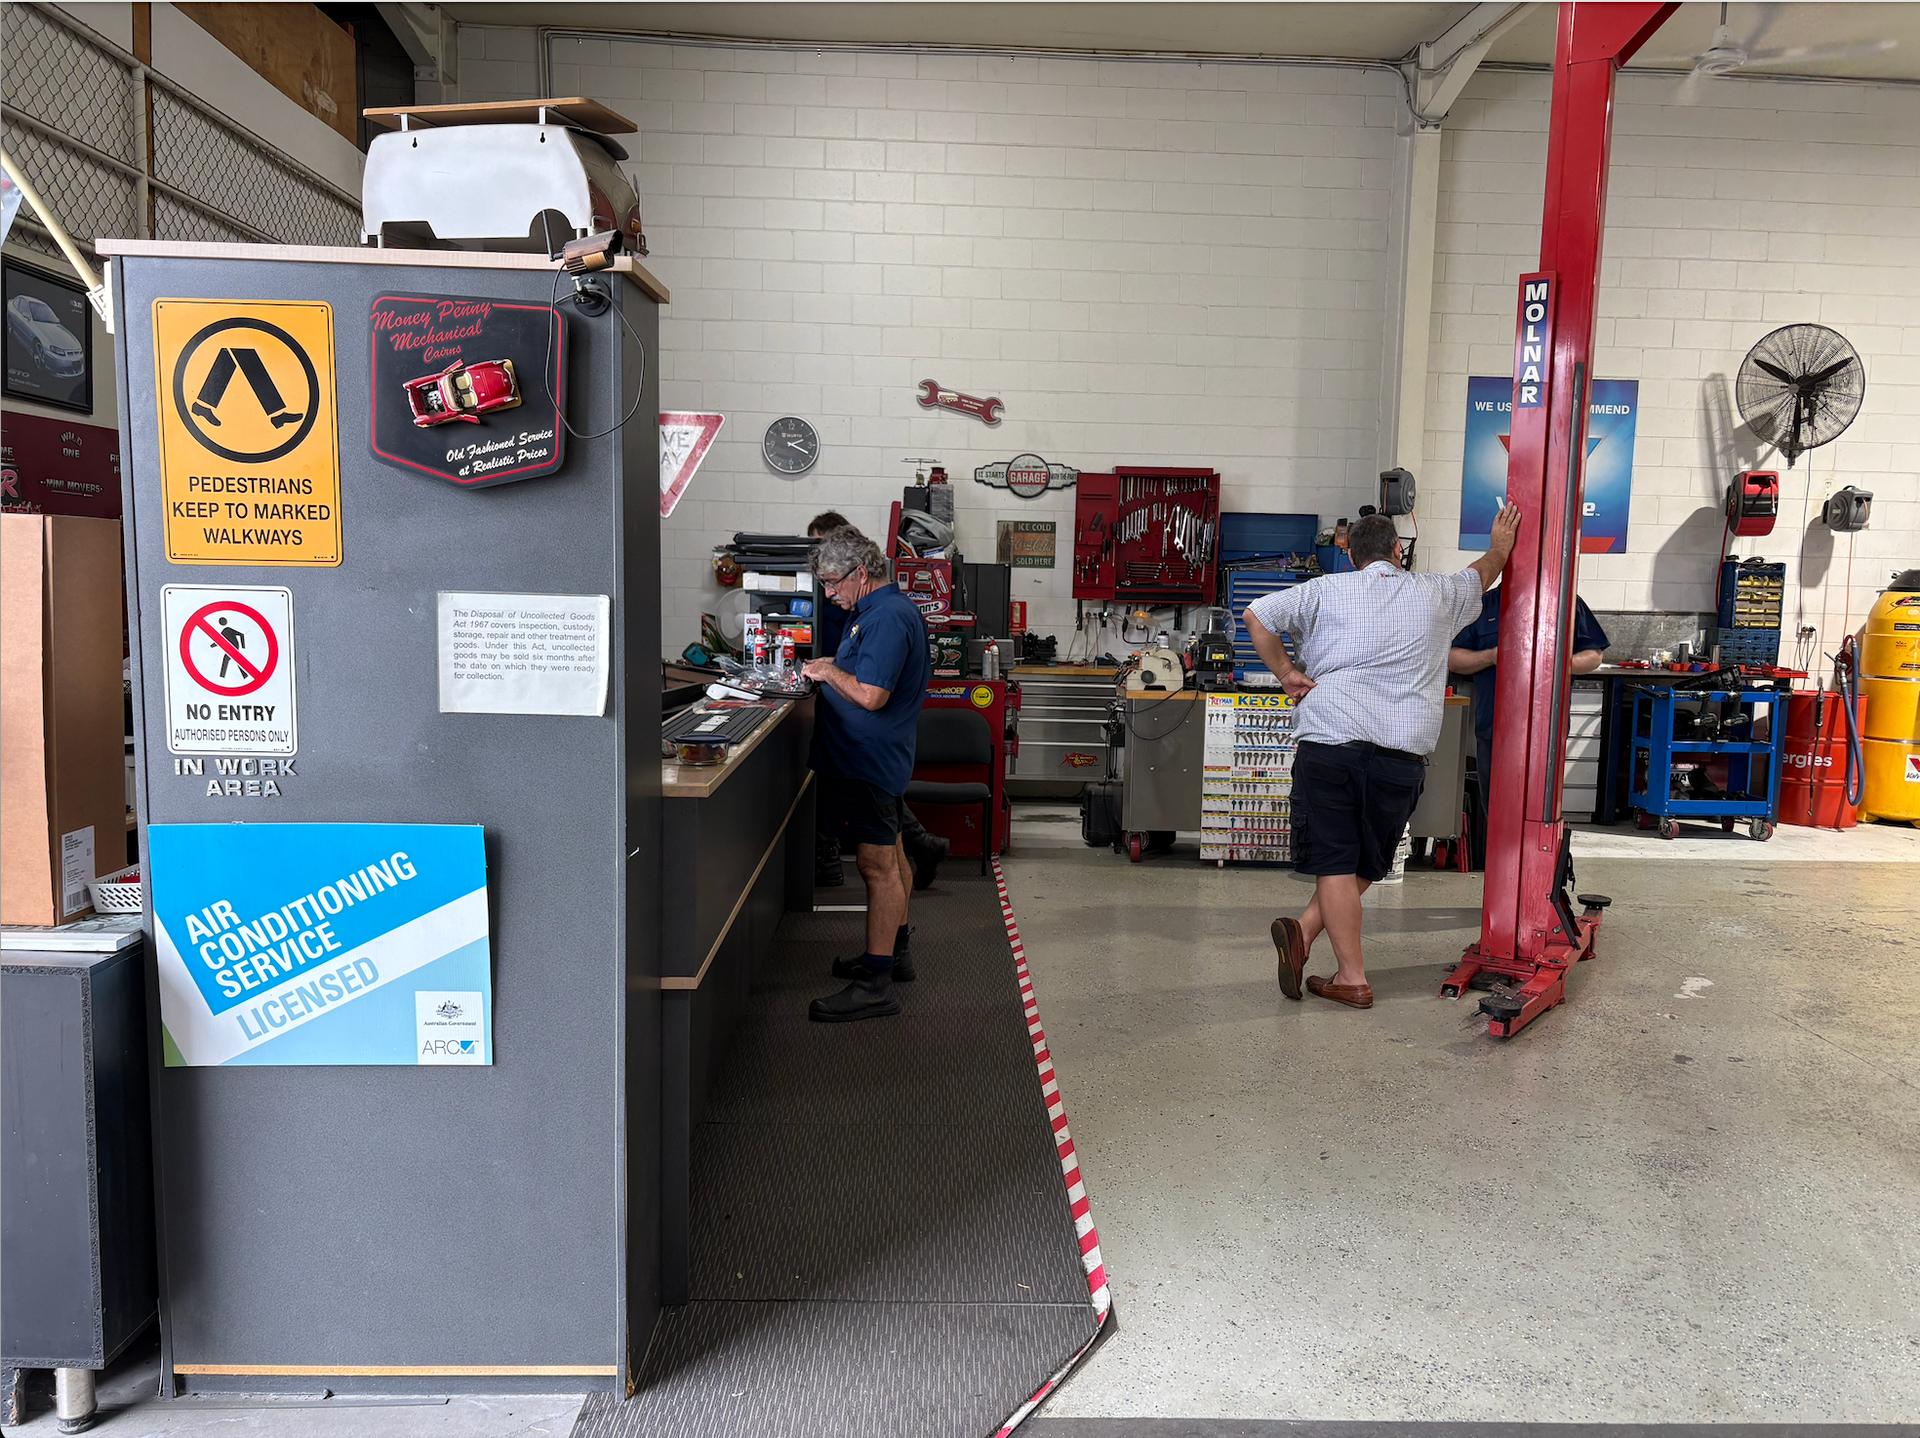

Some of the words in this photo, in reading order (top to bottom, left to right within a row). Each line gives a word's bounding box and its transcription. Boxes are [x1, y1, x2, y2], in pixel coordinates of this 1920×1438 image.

[370, 310, 431, 330] Money
[437, 301, 493, 322] Penny
[390, 319, 483, 351] Mechanical
[1521, 283, 1547, 405] MOLNAR
[424, 345, 462, 363] Cairns
[1475, 402, 1493, 412] WE
[1497, 402, 1512, 412] US
[1589, 405, 1630, 414] MMEND
[60, 432, 82, 446] WILD
[446, 449, 465, 462] Old
[466, 436, 515, 459] Fashioned
[518, 429, 553, 445] Service
[662, 431, 689, 448] VE
[1, 447, 13, 456] ME
[62, 448, 80, 458] ONE
[661, 452, 682, 465] AY
[458, 464, 469, 476] at
[473, 458, 515, 474] Realistic
[517, 447, 548, 462] Prices
[46, 479, 64, 488] MINI
[67, 481, 100, 493] MOVERS
[189, 476, 313, 494] PEDESTRIANS
[1010, 472, 1046, 483] GARAGE
[173, 502, 219, 518] KEEP
[224, 503, 248, 519] TO
[254, 504, 330, 521] MARKED
[203, 528, 303, 546] WALKWAYS
[920, 602, 940, 612] nn's
[519, 622, 560, 631] inspection,
[563, 623, 595, 632] custody,
[454, 642, 479, 650] goods.
[454, 652, 478, 660] goods
[530, 664, 547, 672] they
[1238, 696, 1280, 706] KEYS
[186, 704, 212, 720] NO
[218, 705, 275, 721] ENTRY
[174, 729, 226, 741] AUTHORISED
[228, 730, 266, 742] PERSONS
[268, 730, 289, 742] ONLY
[174, 759, 204, 776] IN
[215, 759, 298, 776] WORK
[1782, 752, 1832, 769] ergies
[206, 780, 281, 797] AREA
[199, 851, 418, 971] CONDITIONING
[184, 898, 241, 945] AIR
[214, 920, 342, 998] SERVICE
[236, 956, 380, 1041] LICENSED
[422, 1040, 460, 1055] ARC
